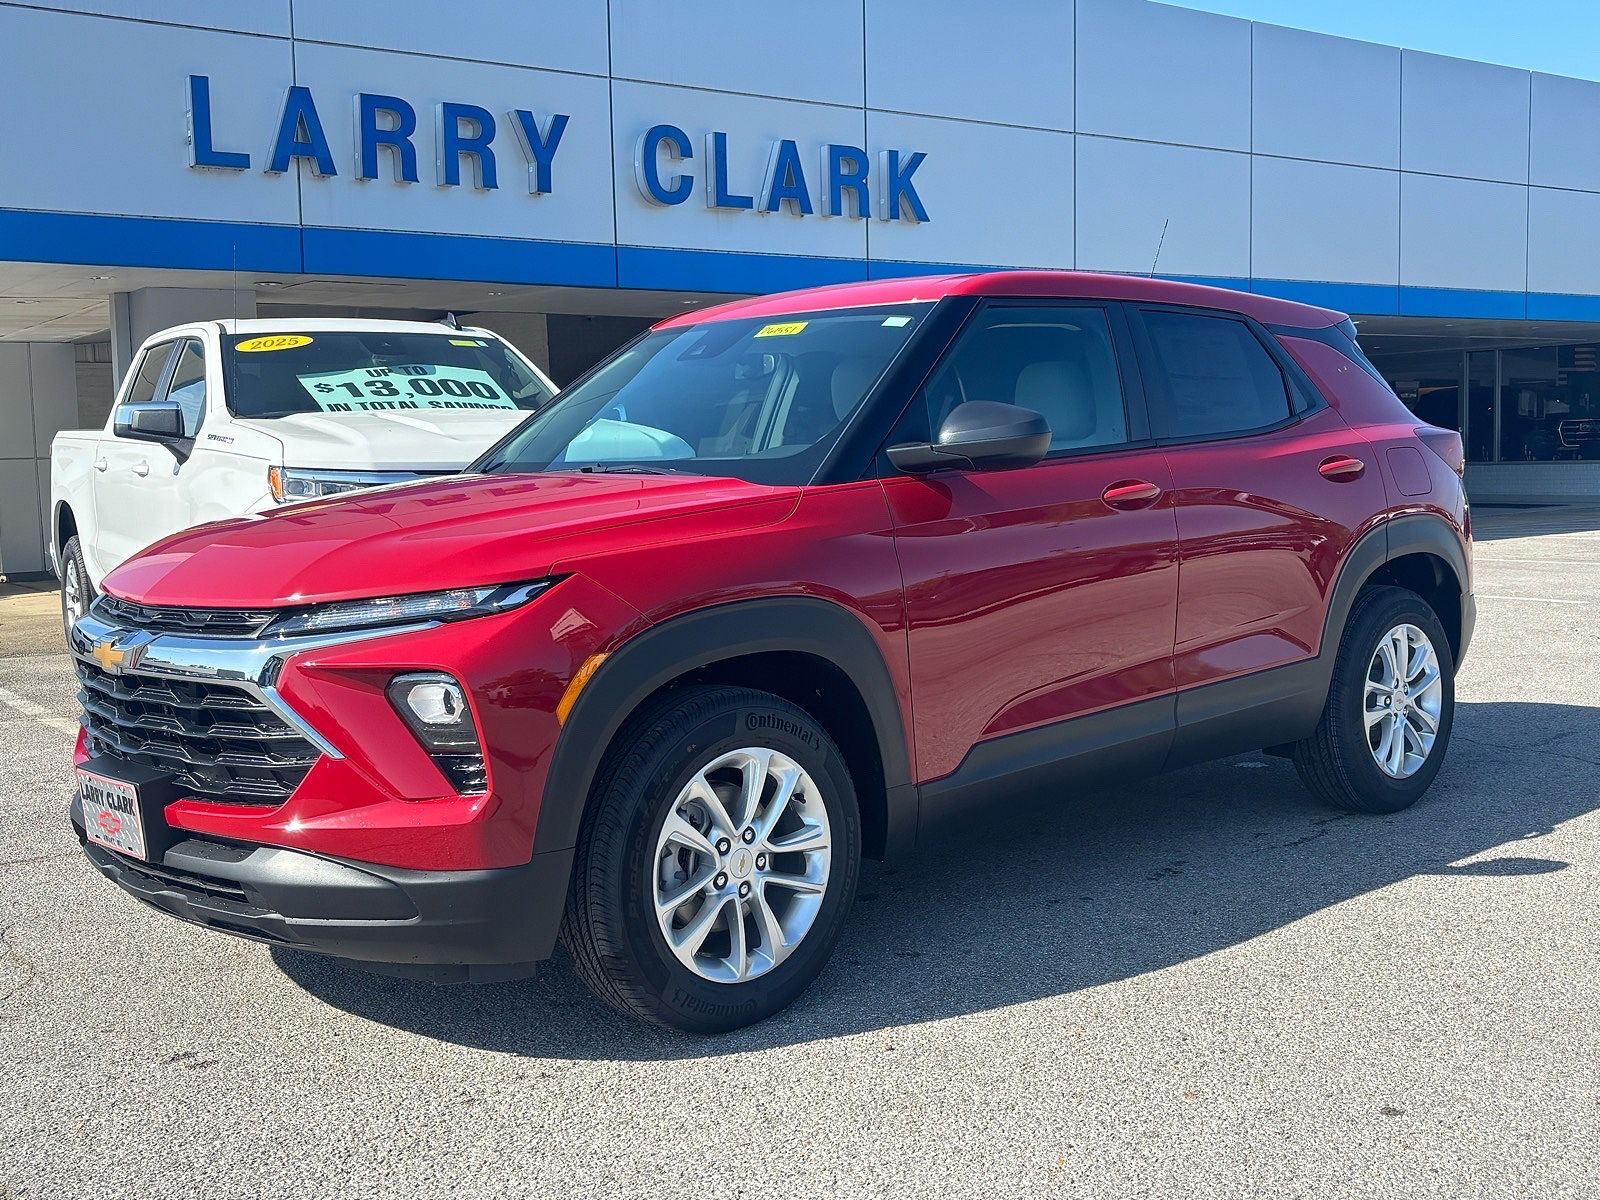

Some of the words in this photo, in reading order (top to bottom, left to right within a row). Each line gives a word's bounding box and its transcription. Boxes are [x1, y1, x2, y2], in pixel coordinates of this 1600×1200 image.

[186, 74, 570, 195] LARRY
[635, 124, 930, 223] CLARK
[251, 337, 299, 350] 2025
[365, 368, 393, 378] UP
[398, 366, 428, 376] TO
[313, 378, 501, 400] $13,000
[80, 782, 105, 807] LARRY
[106, 791, 136, 816] CLARK
